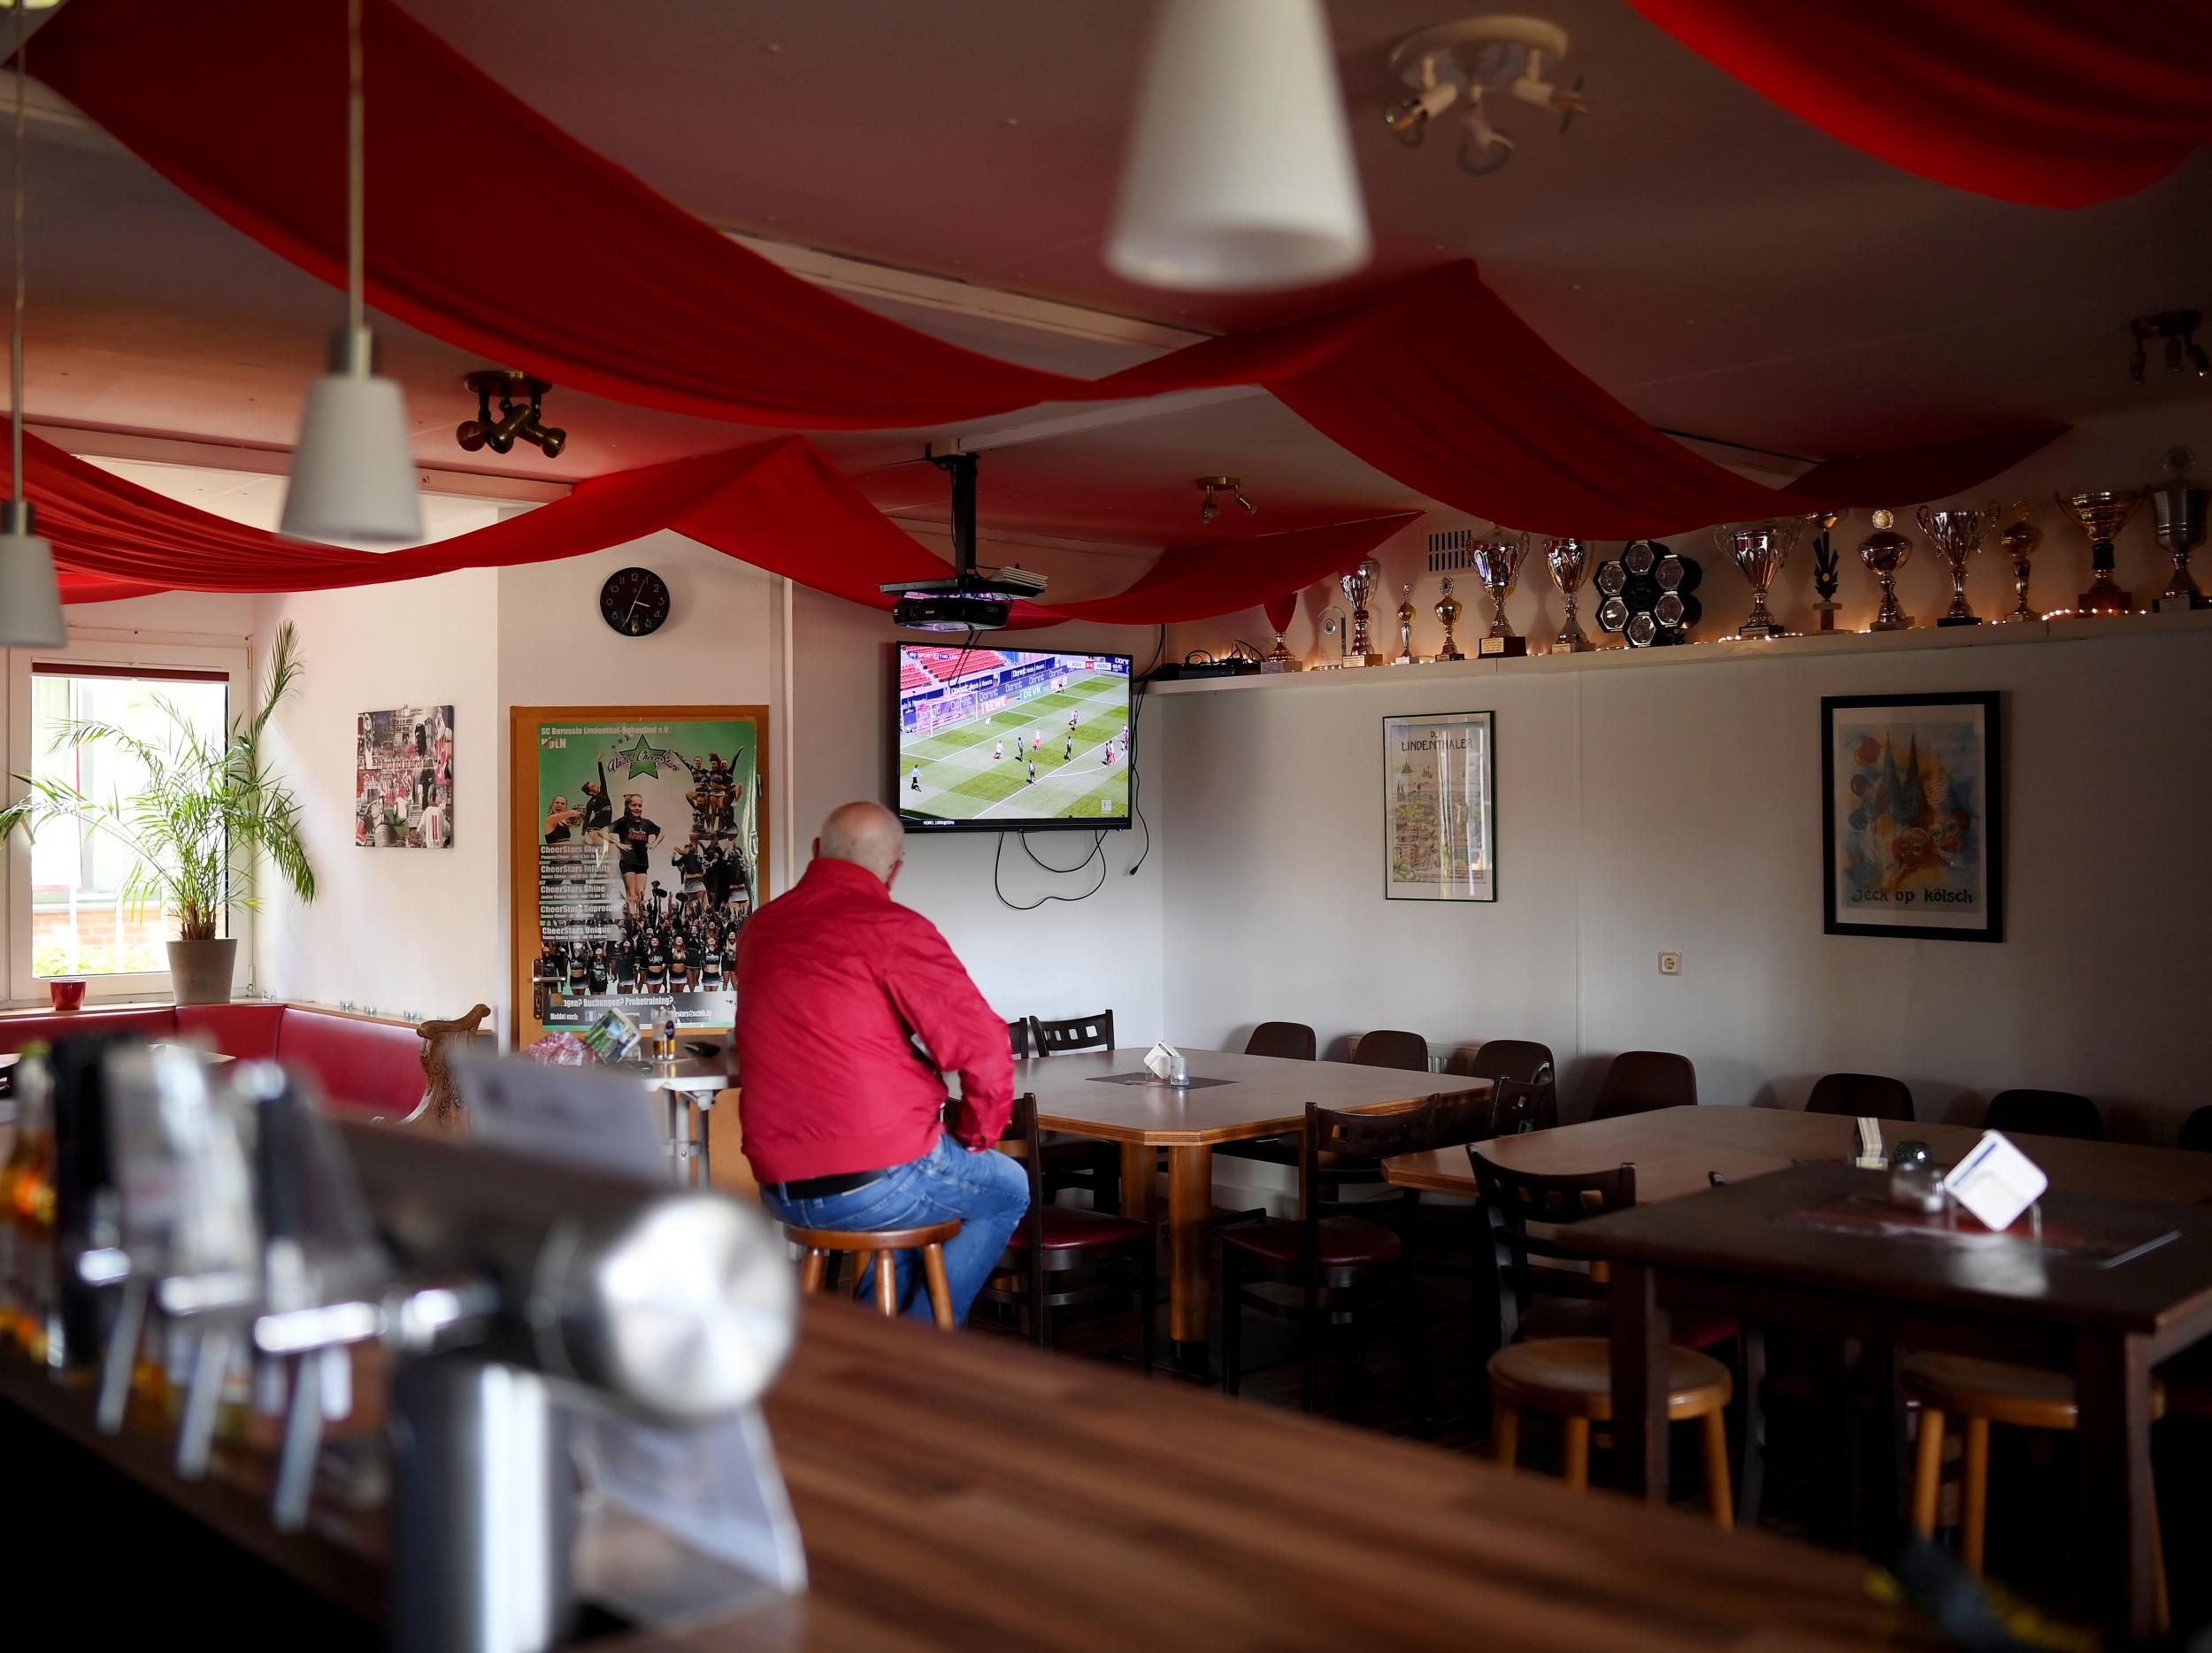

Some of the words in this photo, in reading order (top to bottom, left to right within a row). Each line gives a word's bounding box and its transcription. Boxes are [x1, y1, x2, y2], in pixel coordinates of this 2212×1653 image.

[631, 573, 639, 581] 12
[653, 584, 660, 593] 2
[658, 596, 664, 606] 3
[1005, 680, 1023, 693] Dorint
[979, 689, 999, 702] Dorint
[1023, 686, 1041, 699] DEVK
[541, 727, 551, 735] SC
[551, 727, 583, 735] Borussia
[1430, 729, 1445, 739] DER
[1401, 738, 1473, 751] LINDENTHALER
[607, 755, 636, 773] United
[540, 885, 583, 894] CheerStars
[1895, 889, 1915, 904] op
[585, 926, 612, 934] Unique
[583, 998, 625, 1007] Buchungen?
[625, 996, 673, 1006] Probetraining?
